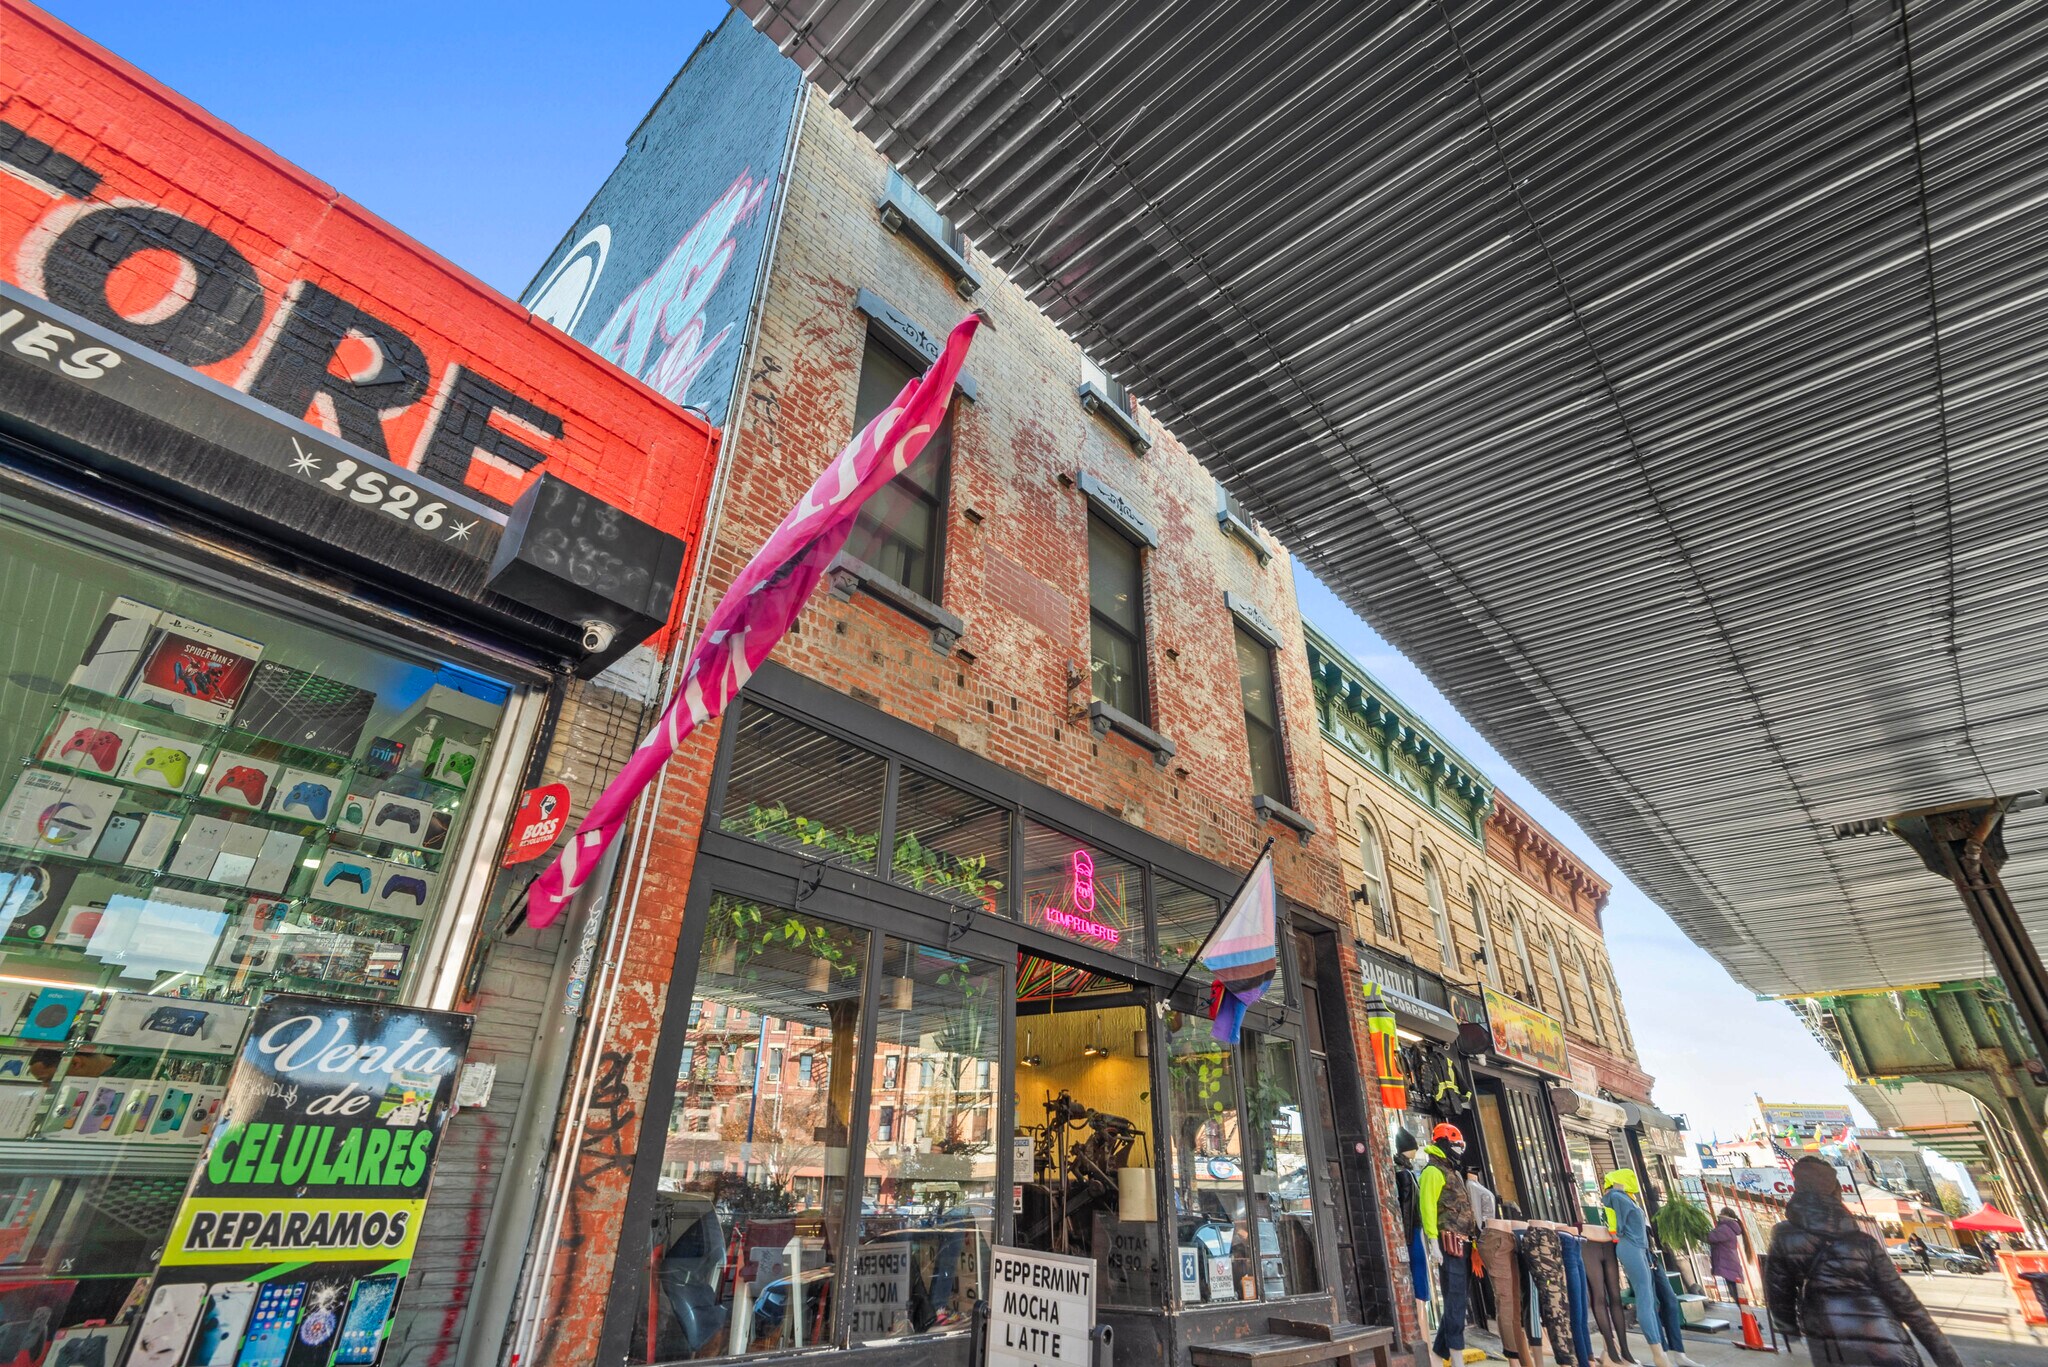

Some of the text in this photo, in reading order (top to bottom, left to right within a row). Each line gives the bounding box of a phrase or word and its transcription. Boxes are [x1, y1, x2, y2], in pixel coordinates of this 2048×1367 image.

[320, 458, 448, 531] 1526
[184, 624, 214, 639] PS5
[184, 644, 226, 666] SPIDER-MAN
[370, 747, 402, 766] mini
[521, 817, 560, 840] BOSS
[258, 1015, 451, 1074] Venta
[305, 1082, 371, 1116] de
[208, 1122, 434, 1188] CELULARES
[184, 1210, 409, 1251] REPARAMOS
[994, 1257, 1090, 1296] PEPPERMINT
[1003, 1291, 1060, 1325] MOCHA
[1006, 1323, 1061, 1359] LATTE
